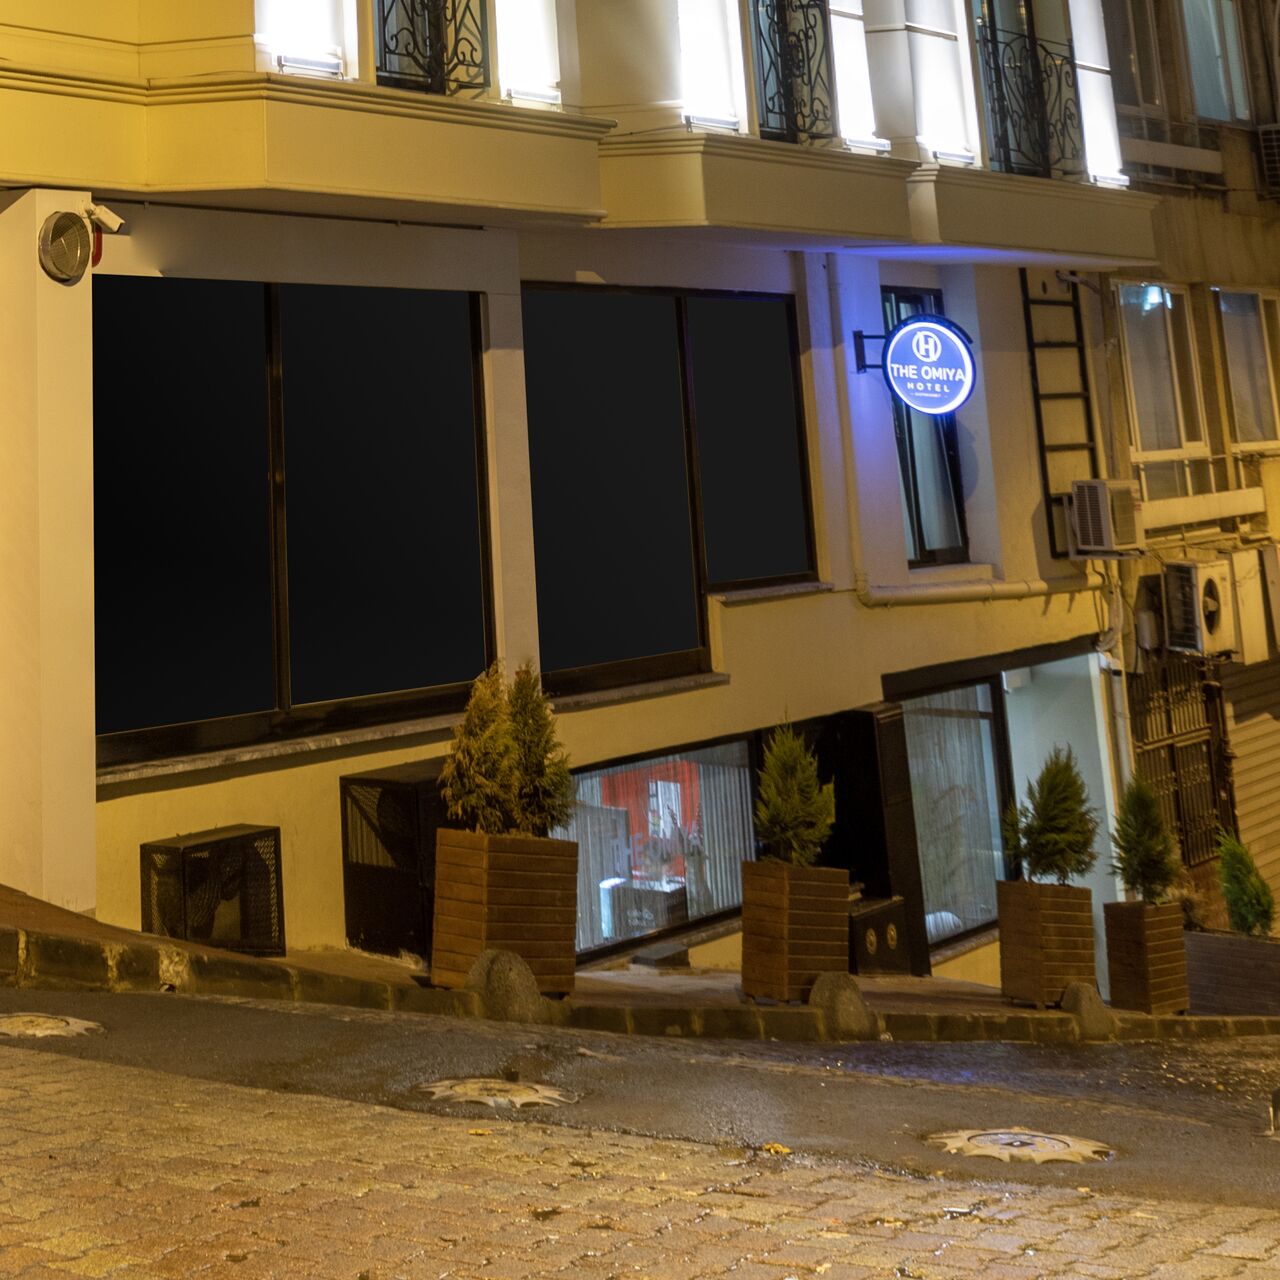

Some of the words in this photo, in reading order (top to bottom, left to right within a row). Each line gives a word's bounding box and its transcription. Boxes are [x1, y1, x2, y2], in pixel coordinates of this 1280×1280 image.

[891, 364, 918, 379] THE
[921, 365, 965, 382] OMIYA
[907, 382, 950, 392] HOTEL
